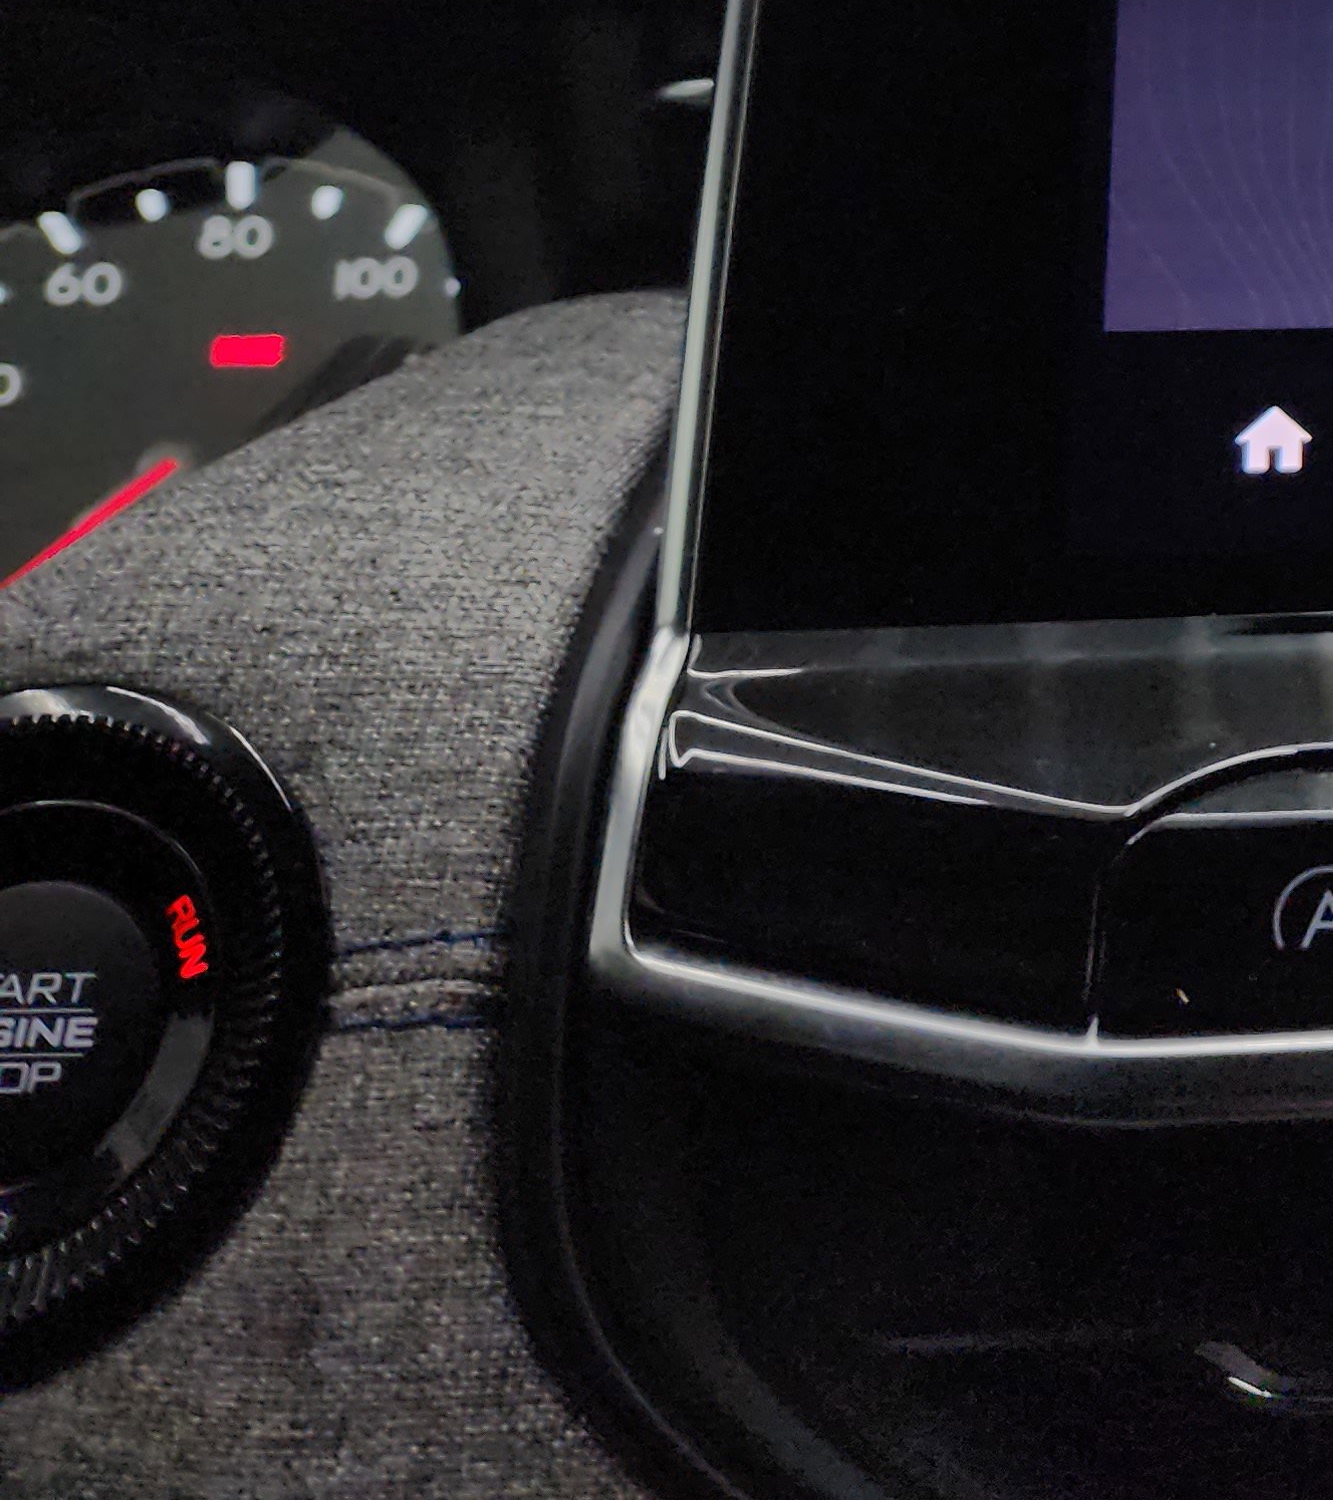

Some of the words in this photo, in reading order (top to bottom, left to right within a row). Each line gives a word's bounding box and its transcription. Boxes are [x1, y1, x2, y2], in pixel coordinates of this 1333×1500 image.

[198, 215, 273, 259] 80
[46, 263, 122, 305] 60
[334, 257, 418, 300] 100
[167, 895, 209, 980] RUN
[0, 972, 97, 1004] ART
